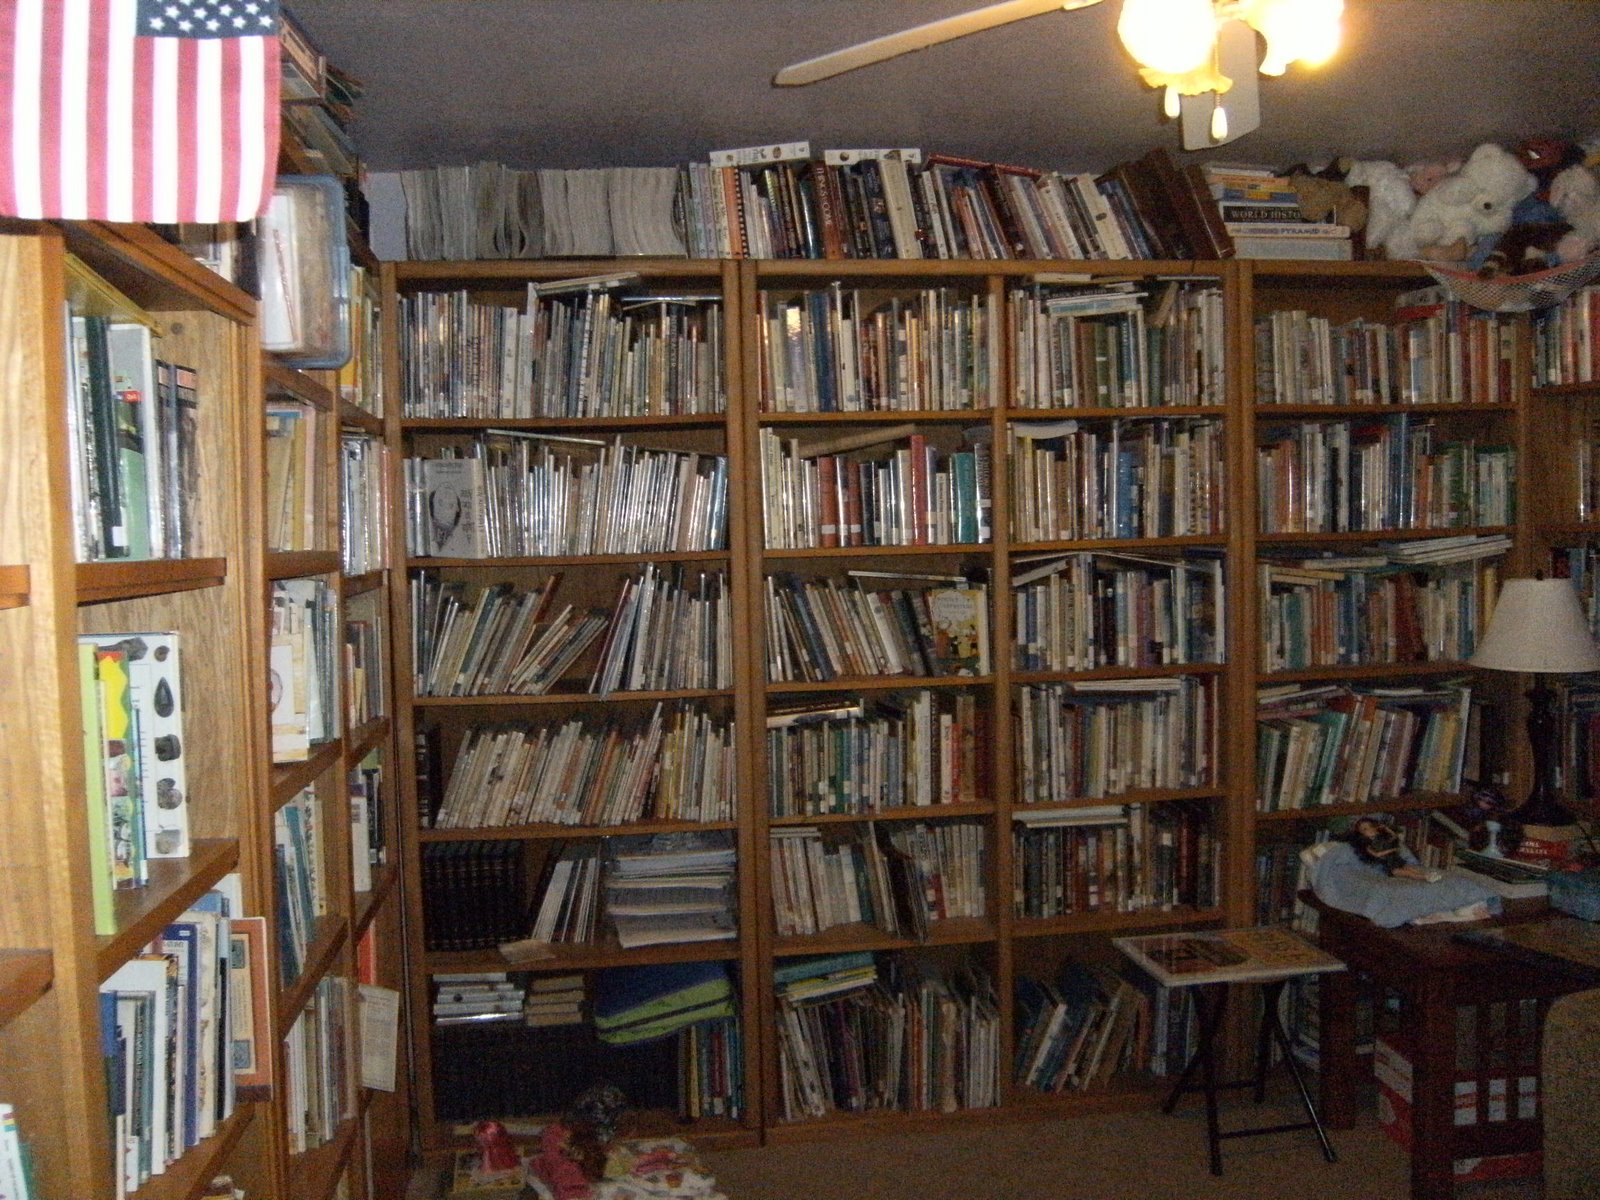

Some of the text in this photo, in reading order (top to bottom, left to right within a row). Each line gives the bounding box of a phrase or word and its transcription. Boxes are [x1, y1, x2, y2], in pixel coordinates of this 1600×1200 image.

[1230, 209, 1301, 219] WORLD HISTO
[1280, 226, 1320, 236] PYRAMID
